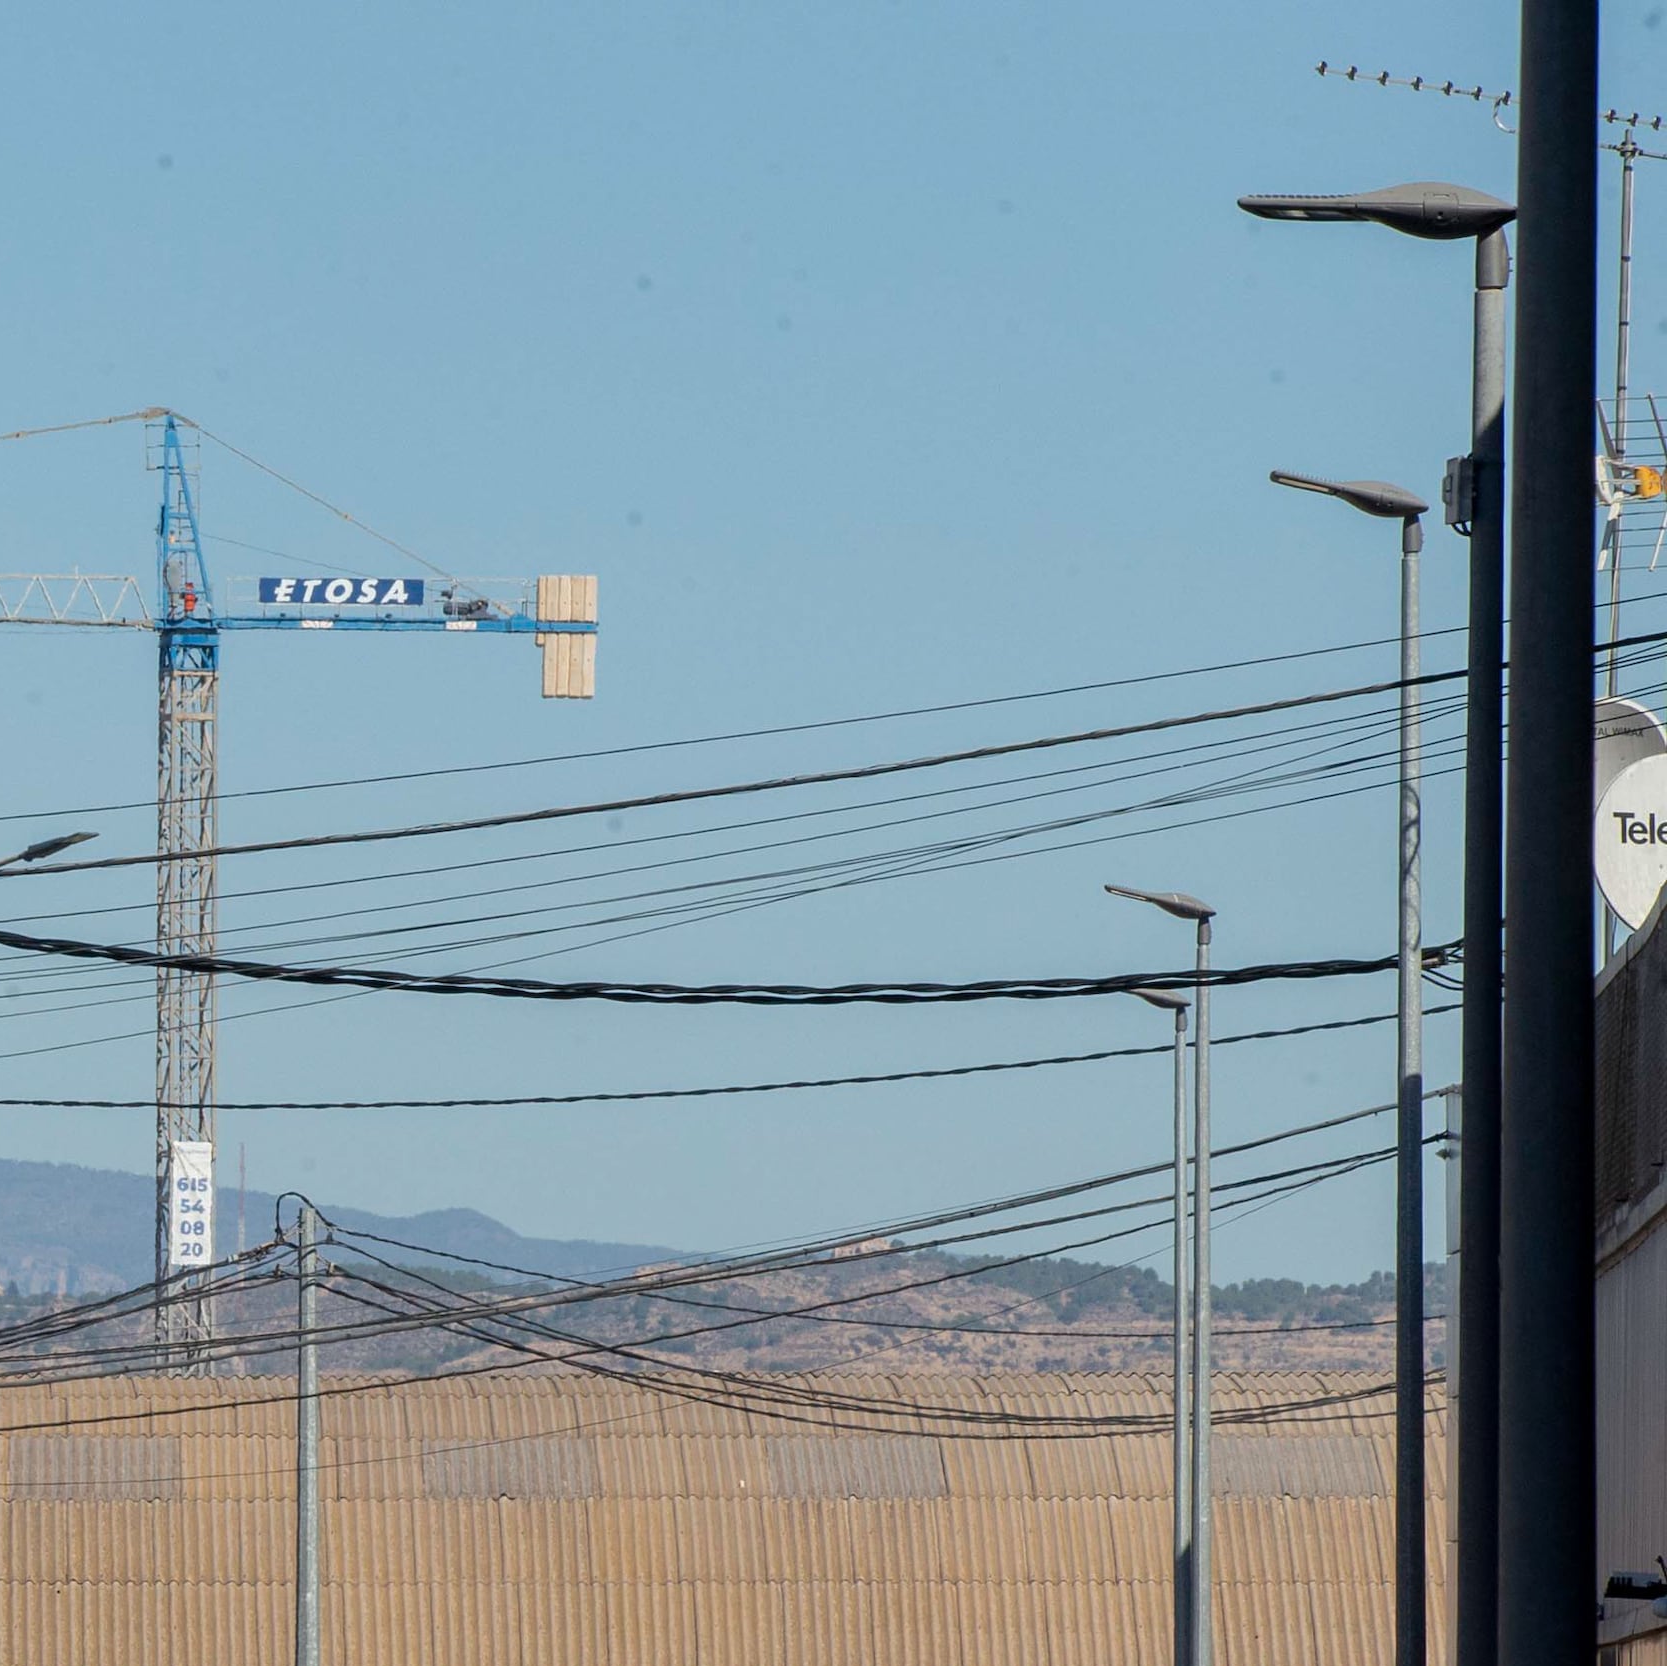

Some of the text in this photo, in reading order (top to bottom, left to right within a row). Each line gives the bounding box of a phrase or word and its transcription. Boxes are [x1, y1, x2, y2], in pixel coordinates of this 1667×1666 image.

[274, 579, 409, 604] ETOSA
[177, 1178, 208, 1192] 615
[180, 1199, 205, 1214] 54
[180, 1220, 205, 1235] 08
[180, 1242, 203, 1257] 20
